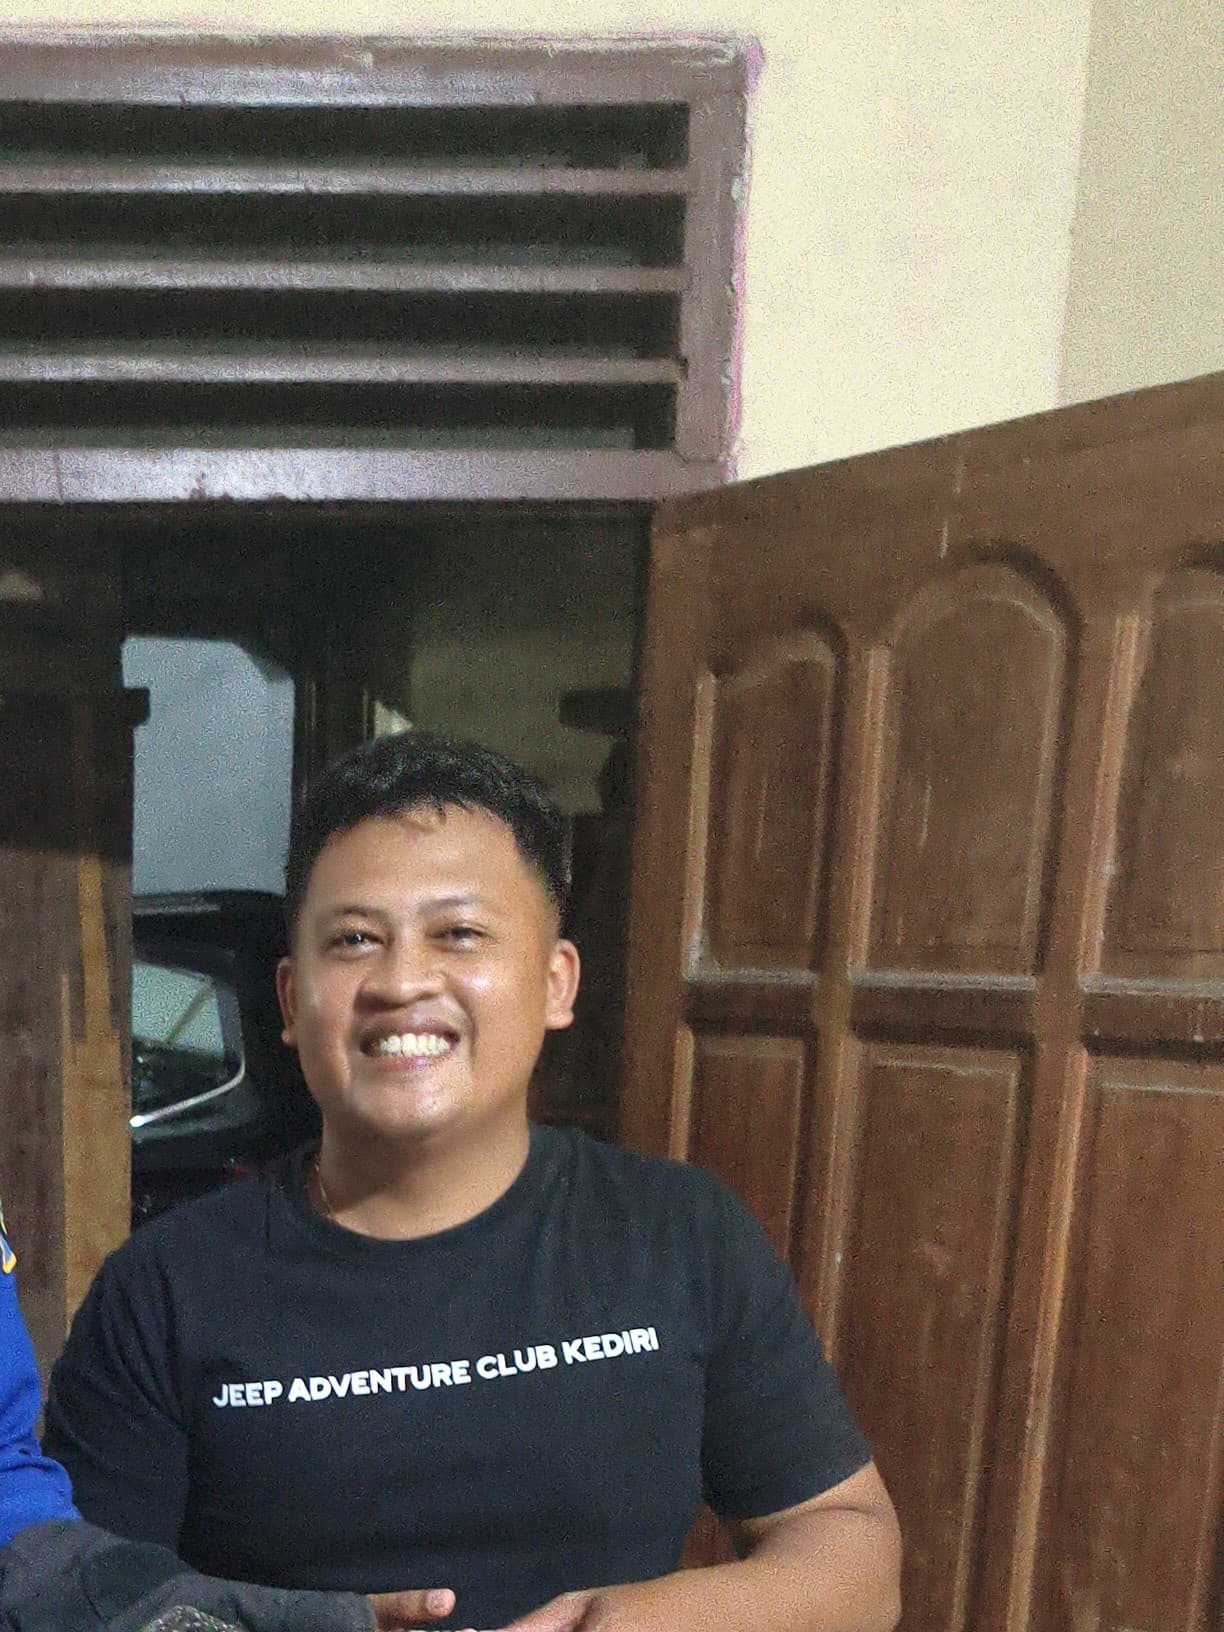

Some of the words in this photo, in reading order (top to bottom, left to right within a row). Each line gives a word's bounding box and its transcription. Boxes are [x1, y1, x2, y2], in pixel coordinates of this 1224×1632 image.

[212, 1380, 283, 1408] JEEP
[287, 1359, 472, 1403] ADVENTURE
[476, 1344, 559, 1380] CLUB
[561, 1326, 660, 1366] KEDIRI
